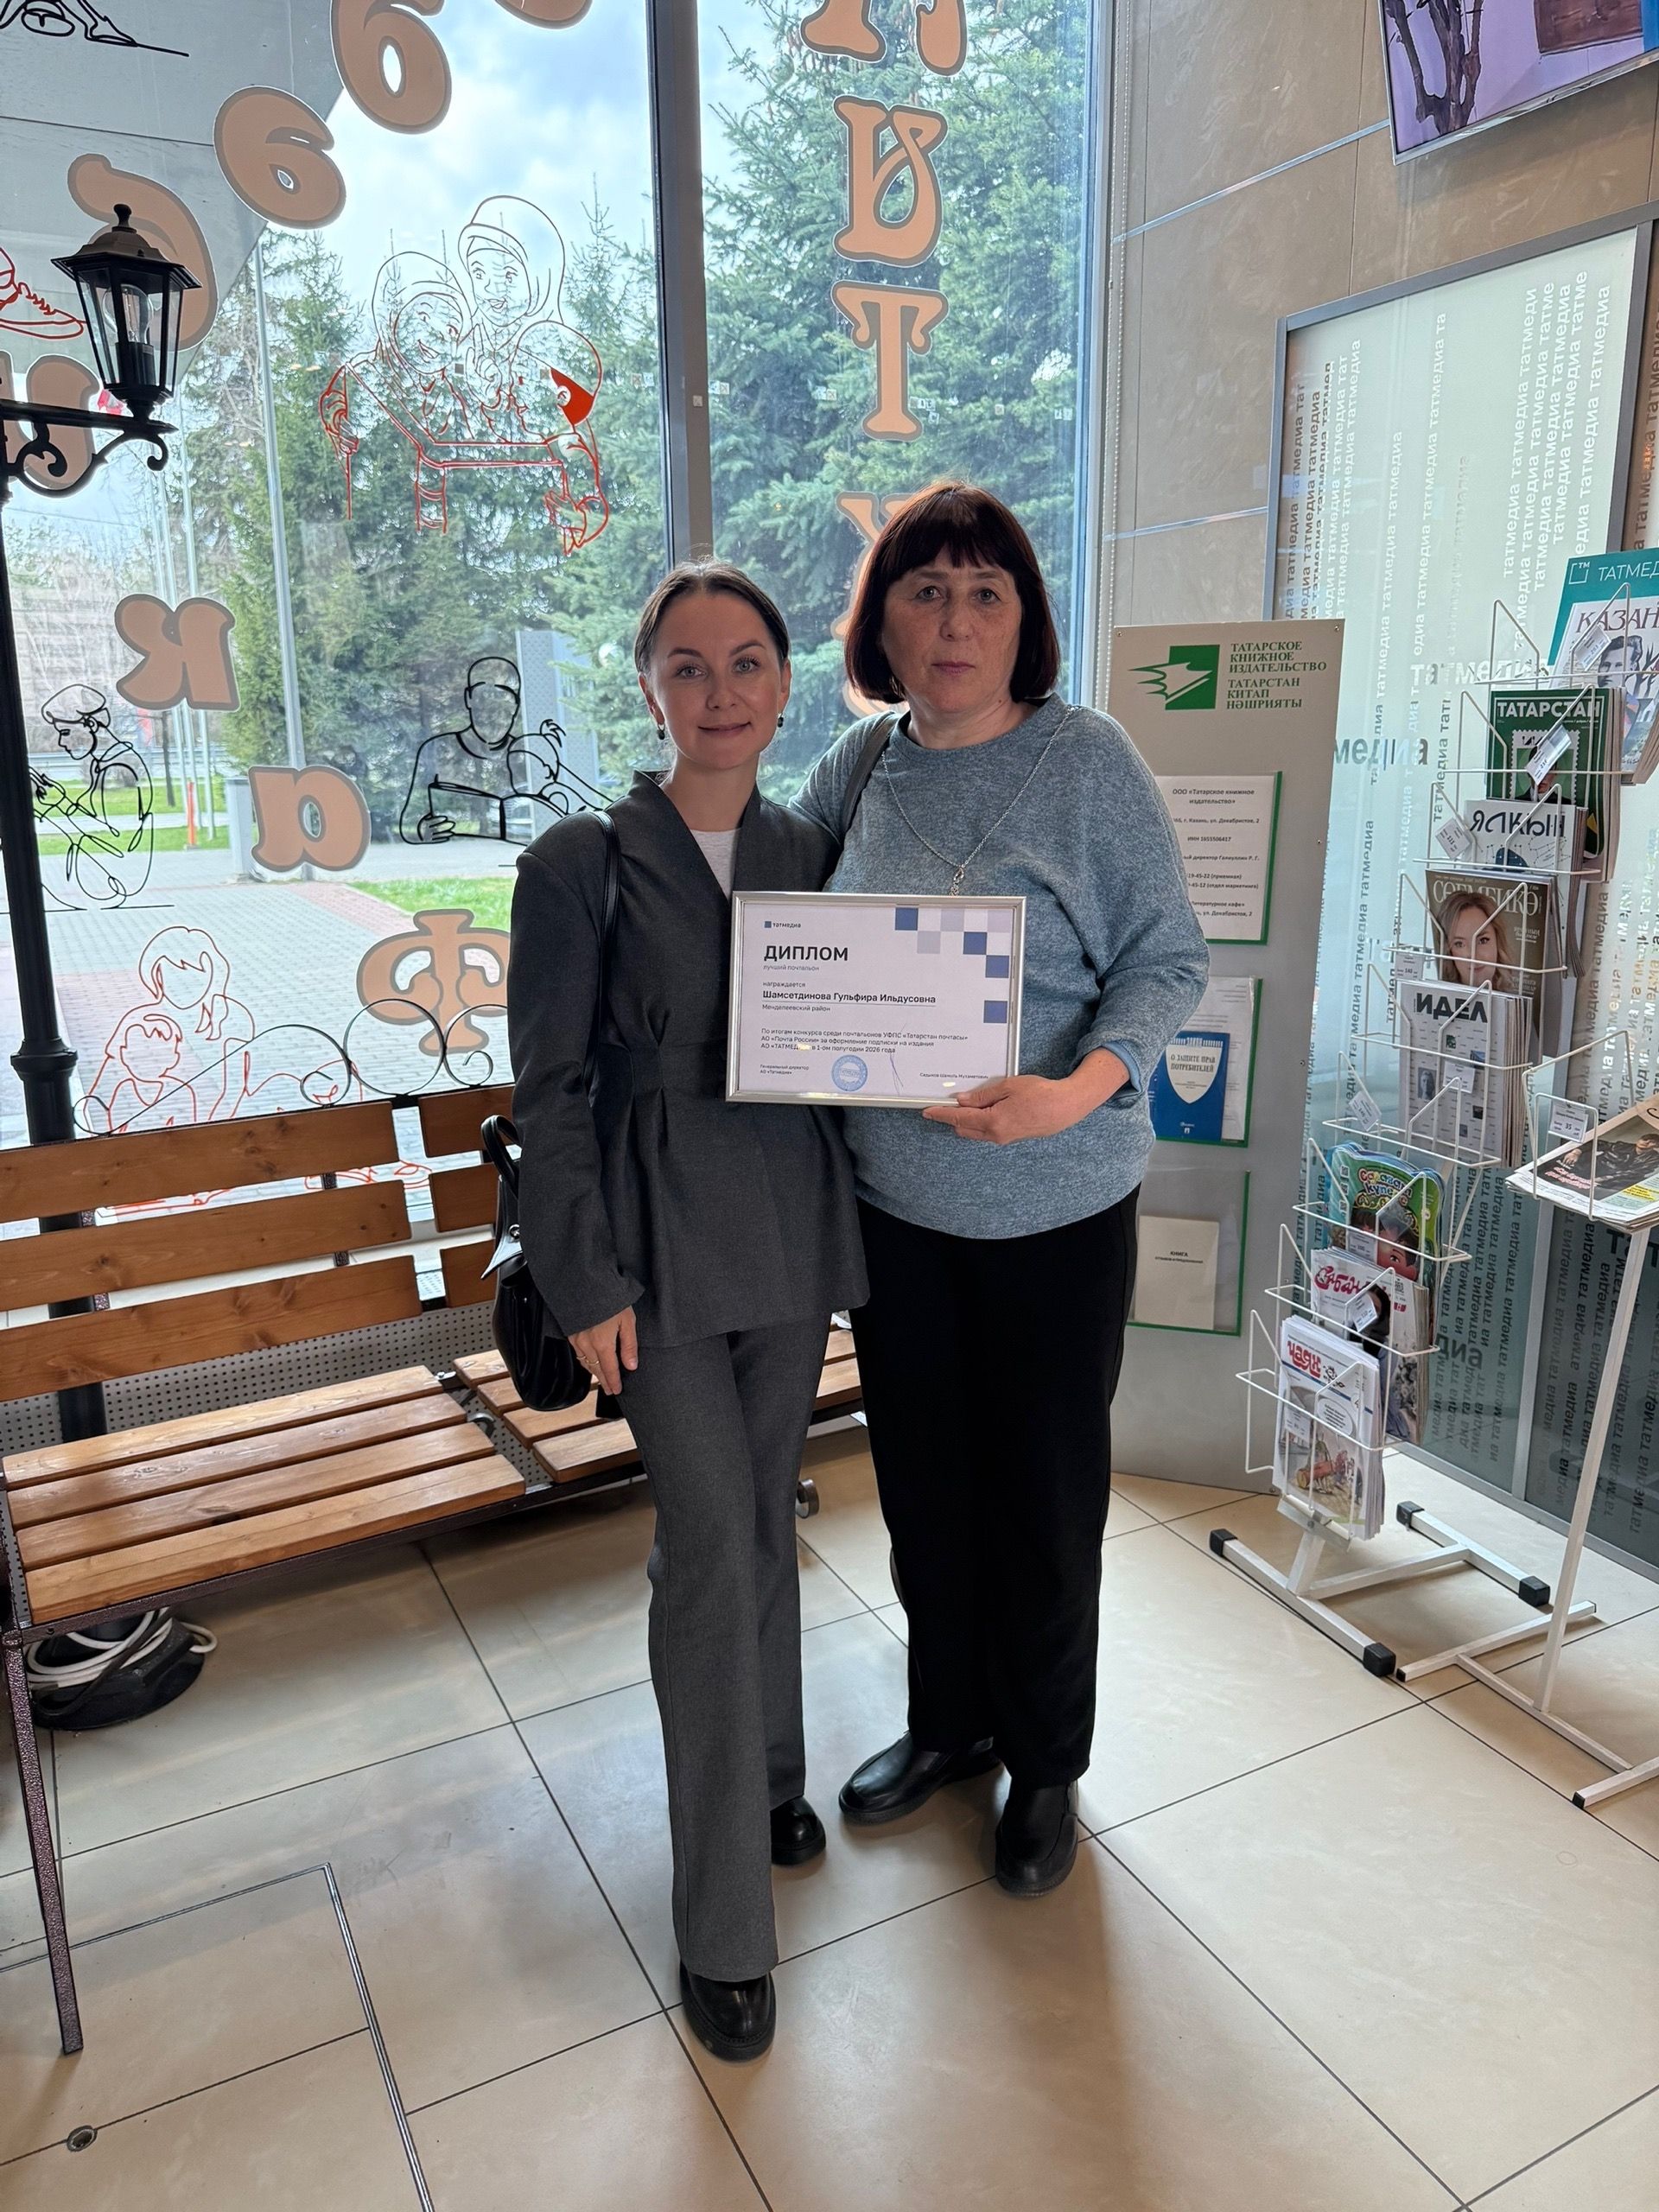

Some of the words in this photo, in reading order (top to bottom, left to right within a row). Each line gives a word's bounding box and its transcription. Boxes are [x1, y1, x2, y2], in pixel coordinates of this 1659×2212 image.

[1520, 288, 1537, 377] татмеди
[1539, 282, 1554, 346] татме
[1552, 283, 1571, 387] татмедиа
[1572, 270, 1587, 335] татме
[1338, 355, 1348, 385] тат
[1347, 340, 1361, 428] татмедиа
[1429, 339, 1445, 429] татмедиа
[1530, 349, 1549, 449] татмедиа
[1560, 340, 1581, 442] татмедиа
[1580, 397, 1599, 499] татмедиа
[1590, 284, 1611, 392] татмедиа
[1308, 391, 1320, 475] татмедиа
[1333, 390, 1346, 474] татмедиа
[1511, 381, 1529, 479] татмедиа
[1542, 391, 1561, 491] татмедиа
[1342, 432, 1355, 518] татмедиа
[1388, 431, 1402, 520] татмедиа
[1423, 433, 1438, 520] татмедиа
[1522, 454, 1540, 552] татмедиа
[1553, 446, 1571, 545] татмедиа
[1287, 503, 1299, 583] татмедиа
[1303, 480, 1316, 562] татмедиа
[1503, 483, 1521, 578] татмедиа
[1534, 495, 1552, 592] татмедиа
[1337, 522, 1350, 606] татмедиа
[1382, 525, 1397, 610] татмедиа
[1416, 524, 1431, 608] татмедиа
[1228, 677, 1300, 689] ТАТАРСТАН
[1230, 652, 1294, 663] КНИЖНОЕ
[1230, 662, 1327, 674] ИЗДАТЕЛЬСТВО
[1231, 641, 1303, 652] ТАТАРСКОЕ
[1376, 615, 1391, 699] татмедиа
[1227, 690, 1269, 699] КИТАП
[1227, 699, 1302, 709] НӘШРИЯТЫ
[1497, 700, 1601, 719] ТАТАРСТАН
[1361, 820, 1374, 899] татмедиа
[764, 945, 849, 962] ДИПЛОМ
[1592, 892, 1610, 972] татмедиа
[763, 990, 831, 1000] Шамсетдинова
[834, 992, 878, 1002] Гульфира
[880, 994, 936, 1003] Ильдусовна
[1416, 992, 1489, 1024] ИДЕЛ
[1474, 1203, 1489, 1271] татмедиа
[1483, 1254, 1497, 1325] татмедиа
[1490, 1176, 1505, 1249] татмедиа
[1505, 1222, 1521, 1294] татмедиа
[1556, 1230, 1573, 1306] татмедиа
[1578, 1223, 1595, 1301] татмедиа
[1498, 1298, 1513, 1367] татмедиа
[1593, 1262, 1611, 1338] татмедиа
